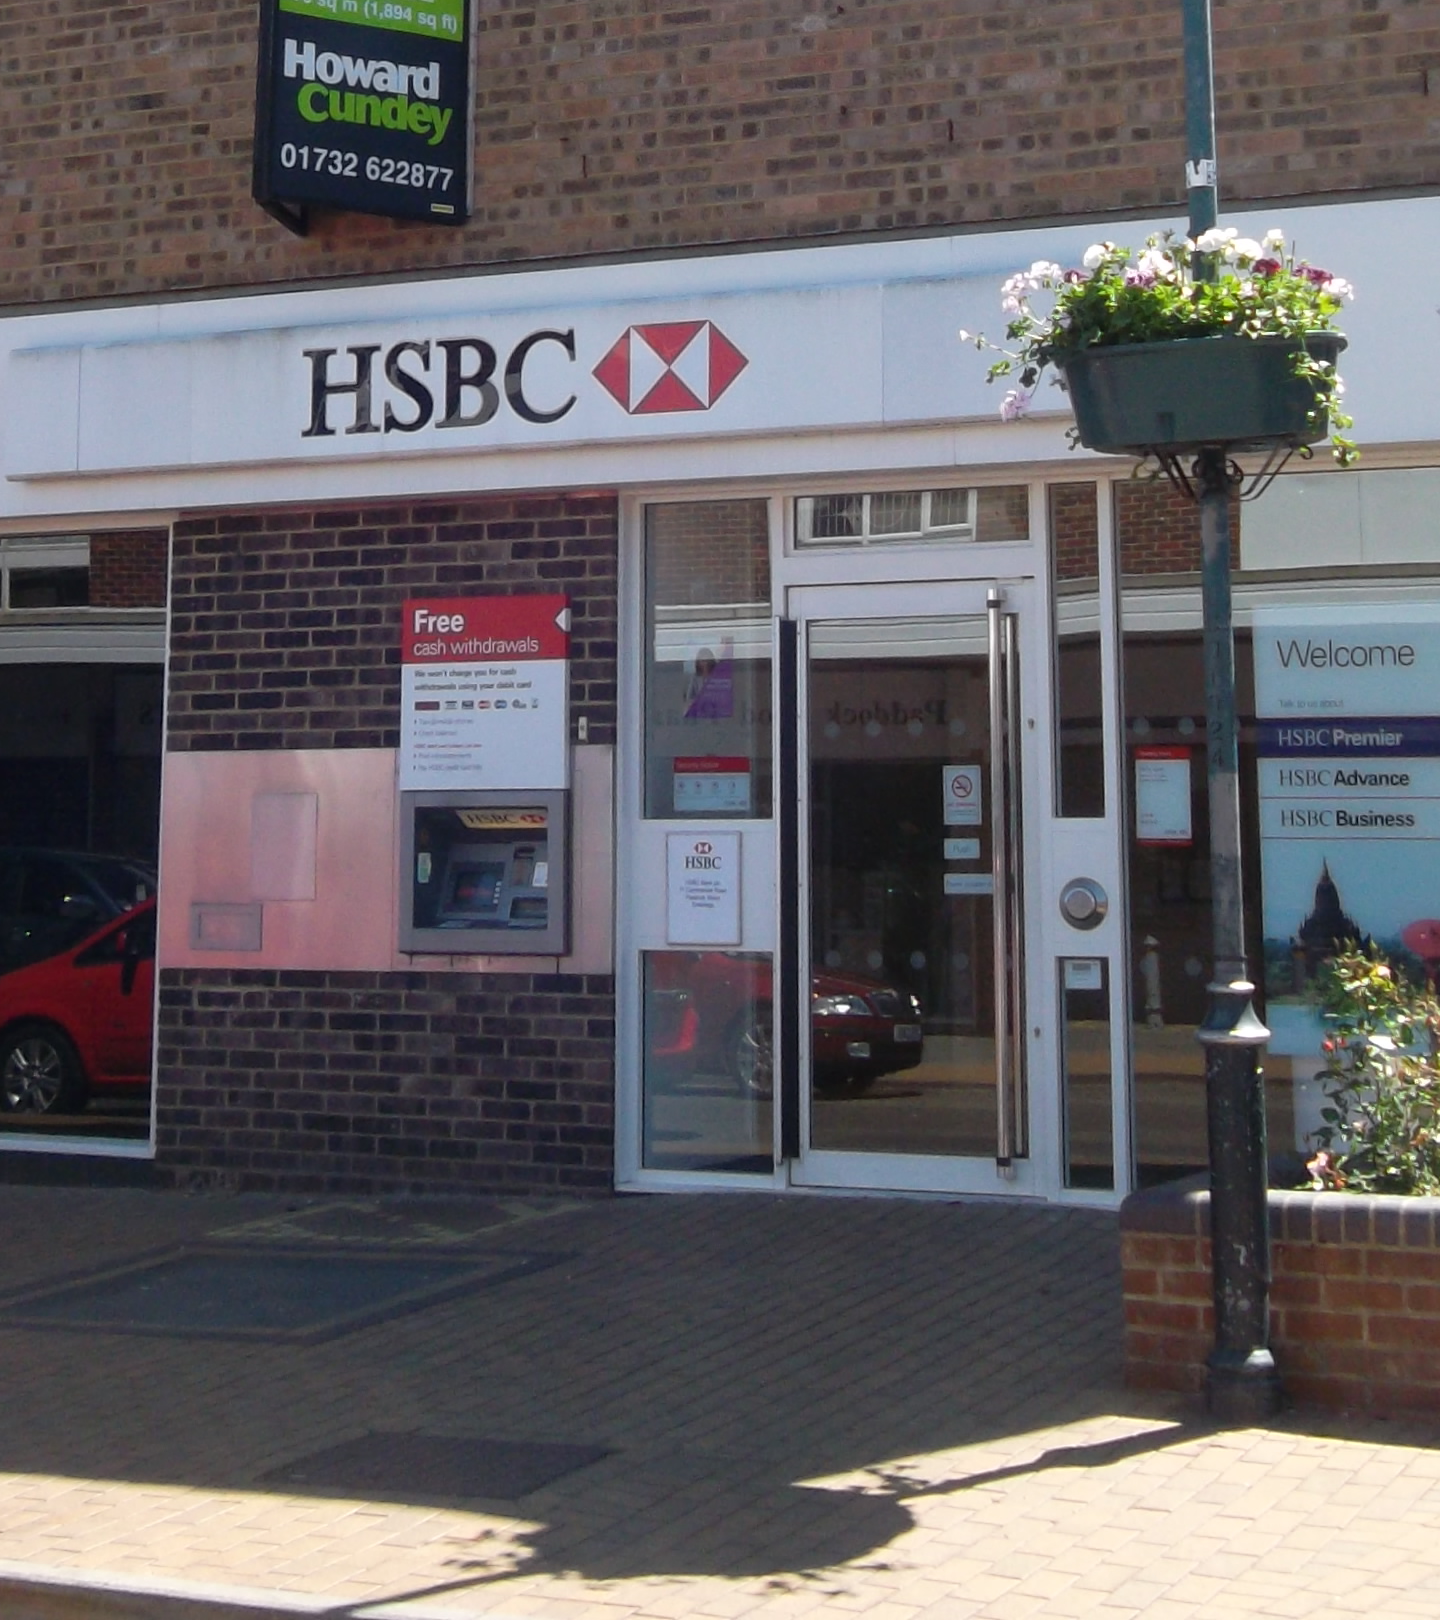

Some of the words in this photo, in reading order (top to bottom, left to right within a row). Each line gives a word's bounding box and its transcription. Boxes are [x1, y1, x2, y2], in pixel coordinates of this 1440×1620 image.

[364, 0, 412, 23] (1,894
[418, 11, 437, 31] sq
[441, 12, 457, 34] ft)
[283, 38, 440, 100] Howard
[297, 82, 453, 146] Cundey
[281, 142, 359, 178] 01732
[365, 156, 454, 191] 622877
[301, 326, 578, 438] HSBC
[414, 609, 464, 633] Free
[413, 638, 446, 656] cash
[450, 636, 539, 655] withdrawals
[1276, 639, 1416, 669] Welcome
[1278, 729, 1330, 747] HSBC
[1333, 728, 1404, 747] Premier
[1279, 768, 1331, 787] HSBC
[1333, 768, 1410, 787] Advance
[466, 814, 519, 824] HSBC
[1280, 809, 1331, 828] HSBC
[1335, 808, 1415, 828] Business
[684, 856, 722, 870] HSBC
